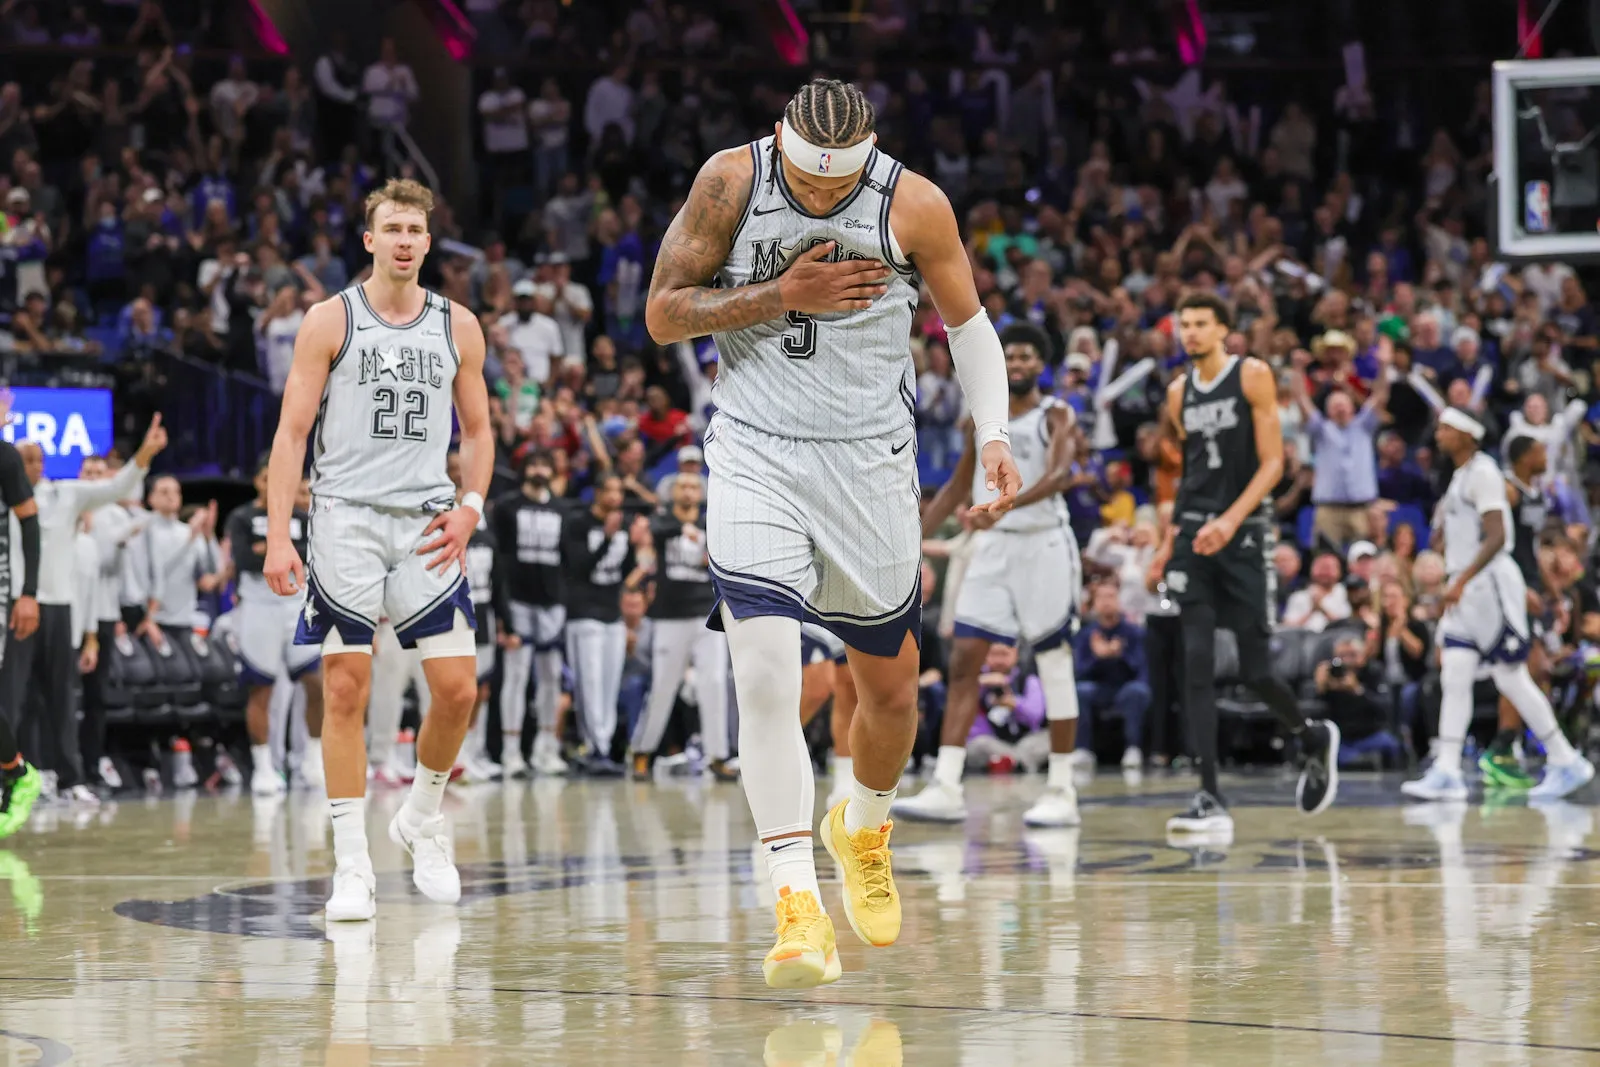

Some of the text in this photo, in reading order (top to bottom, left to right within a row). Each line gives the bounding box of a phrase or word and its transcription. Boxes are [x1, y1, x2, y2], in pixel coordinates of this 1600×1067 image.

[781, 310, 817, 360] 5
[370, 386, 428, 442] 22
[1205, 441, 1223, 470] 1
